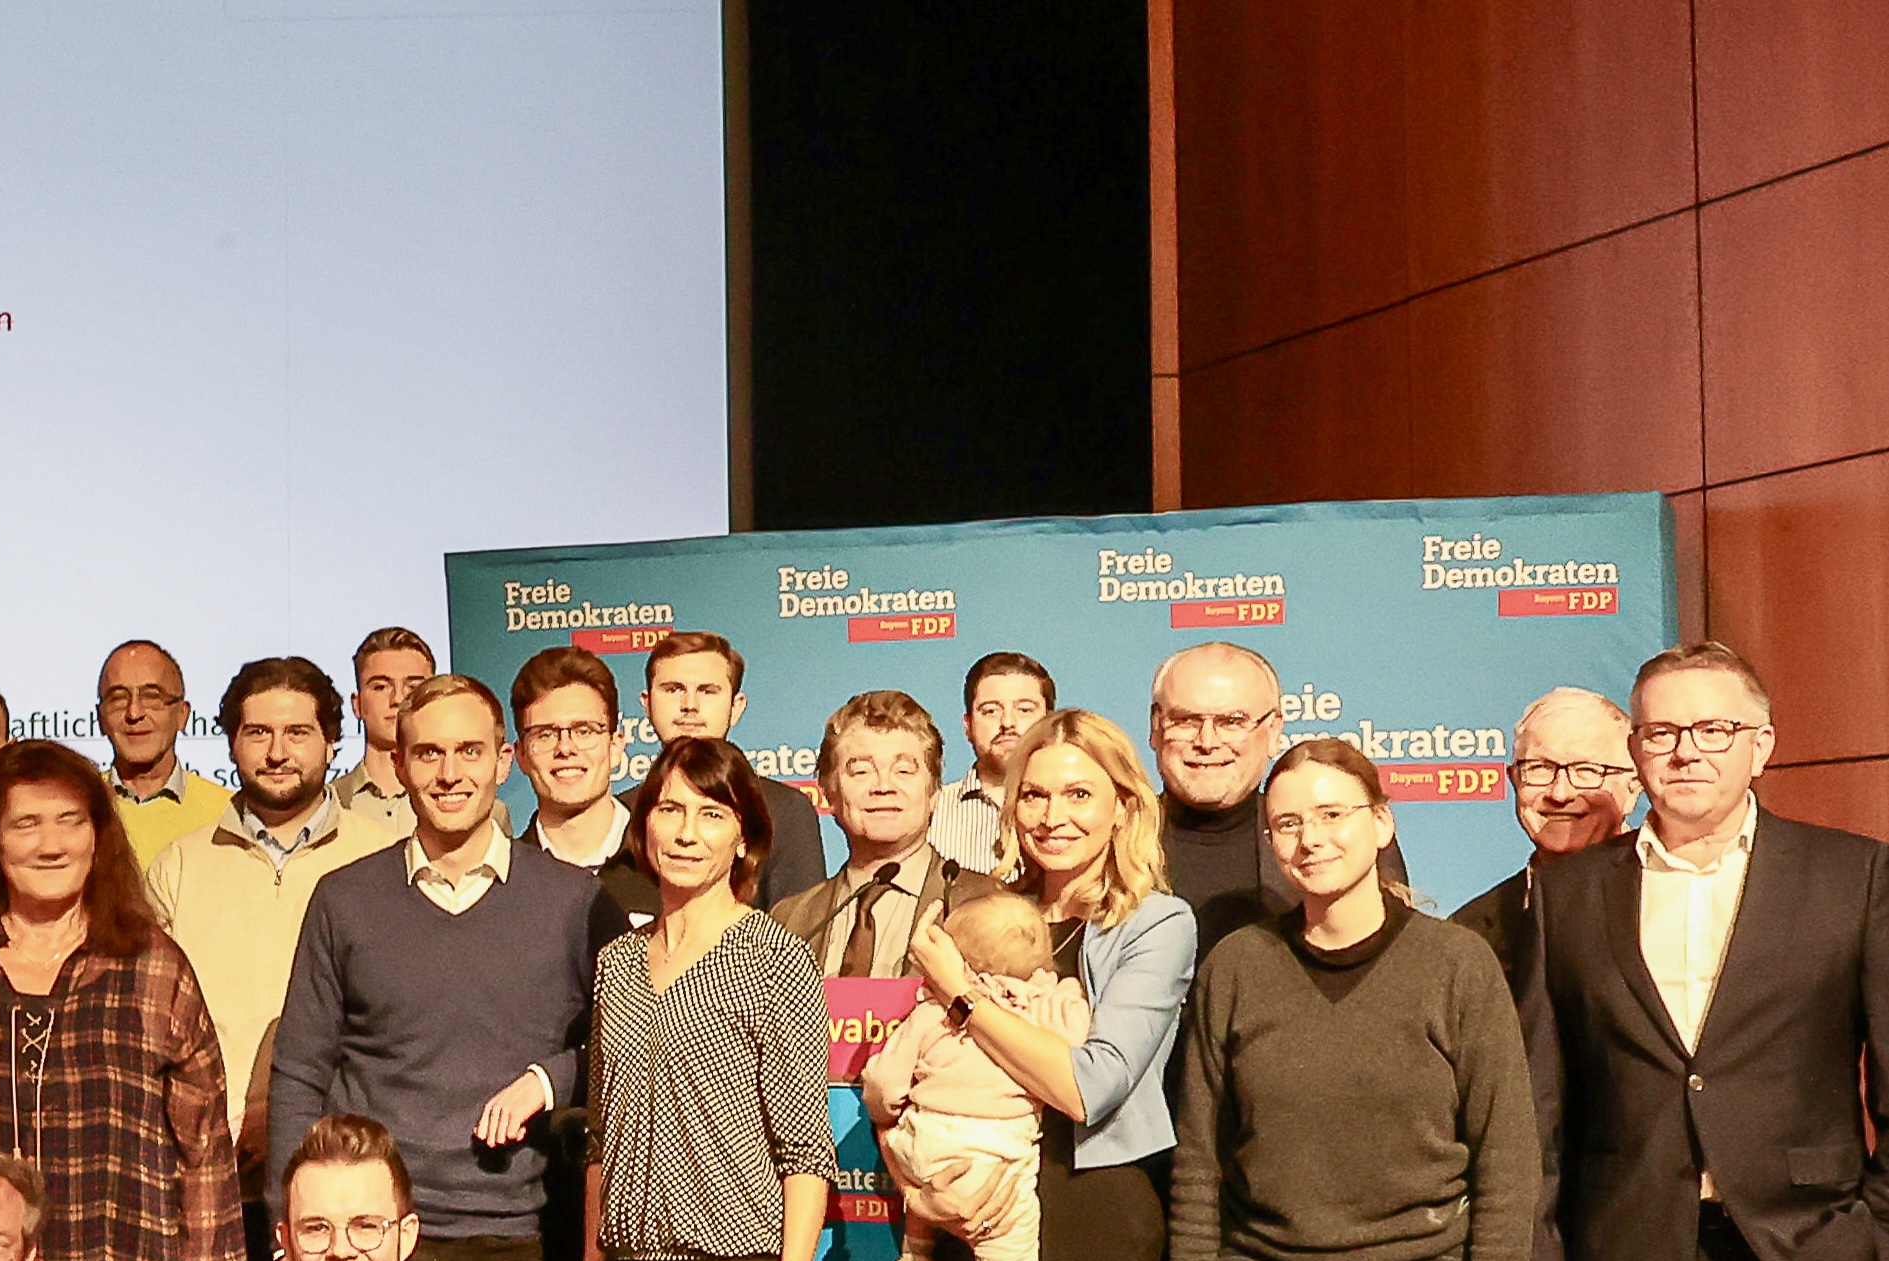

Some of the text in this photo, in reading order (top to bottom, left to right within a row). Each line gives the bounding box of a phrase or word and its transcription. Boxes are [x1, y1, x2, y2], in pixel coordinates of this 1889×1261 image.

[1098, 547, 1172, 575] Freie
[1422, 533, 1502, 561] Freie
[778, 564, 849, 592] Freie
[1098, 572, 1285, 602] Demokraten
[1422, 558, 1619, 590] Demokraten
[504, 578, 571, 606] Freie
[779, 587, 956, 618] Demokraten
[1568, 592, 1613, 610] FDP
[506, 601, 674, 631] Demokraten
[911, 617, 952, 635] FDP
[1237, 603, 1280, 621] FDP
[1389, 769, 1499, 794] Bayern FDP
